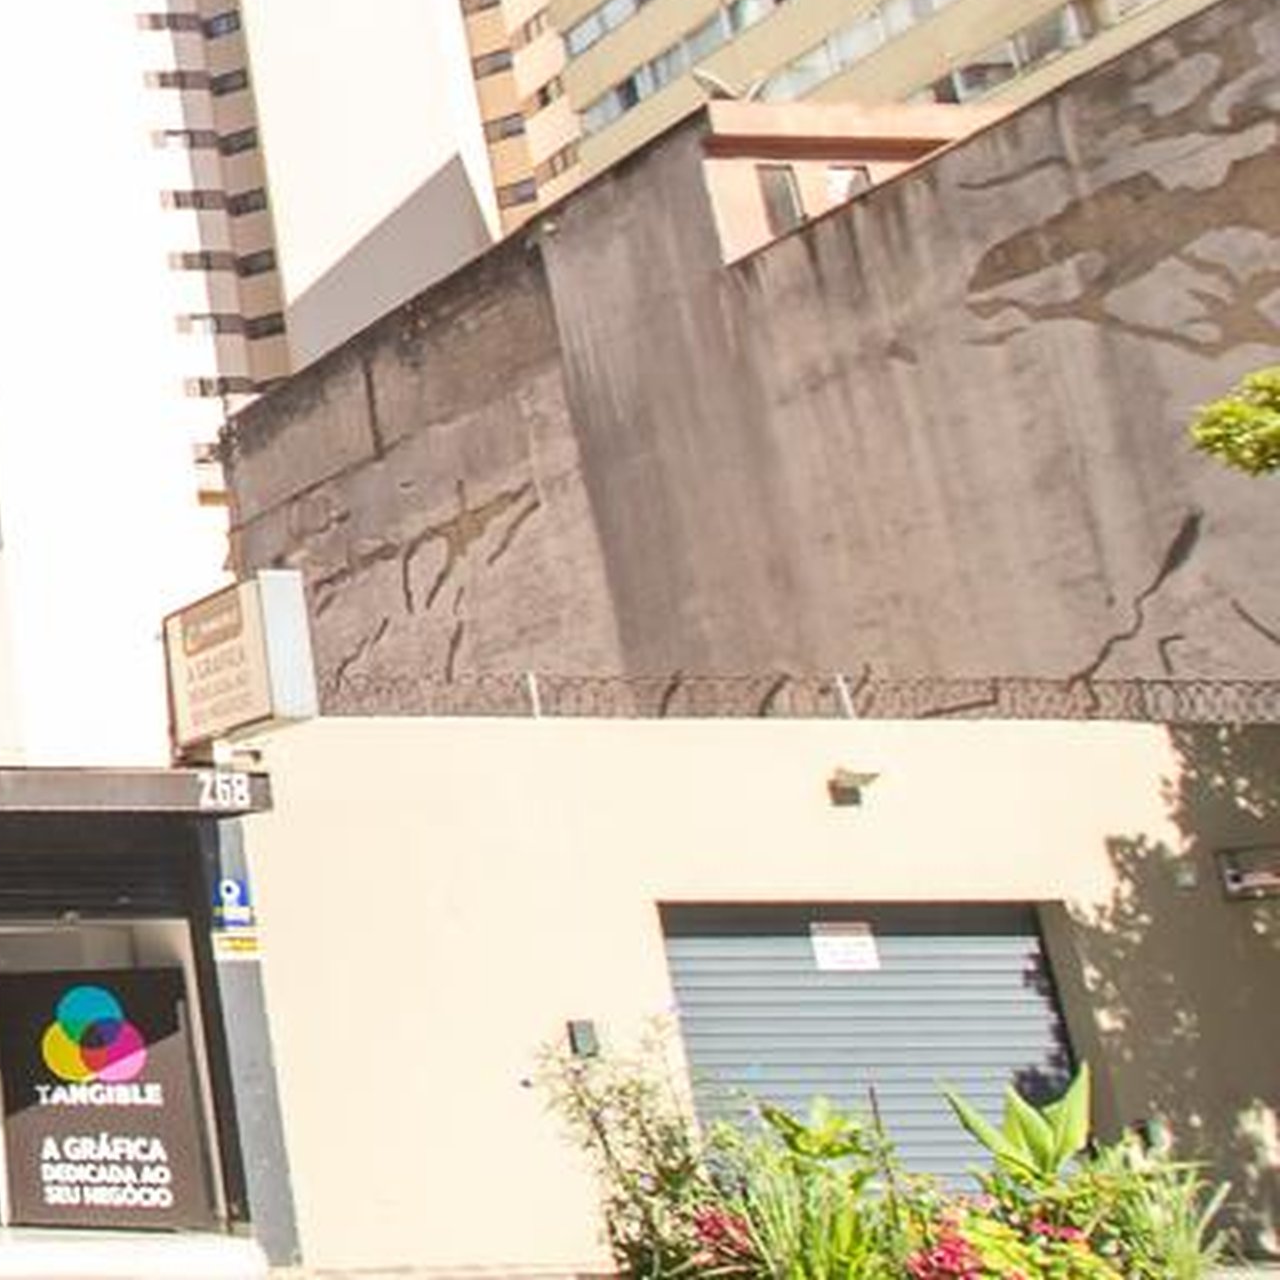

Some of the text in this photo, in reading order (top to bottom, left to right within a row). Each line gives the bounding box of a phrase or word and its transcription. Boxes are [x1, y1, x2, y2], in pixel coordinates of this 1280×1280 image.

[197, 772, 252, 810] 268
[34, 1082, 165, 1107] TANGIBLE
[41, 1131, 169, 1163] A GRÁFICA
